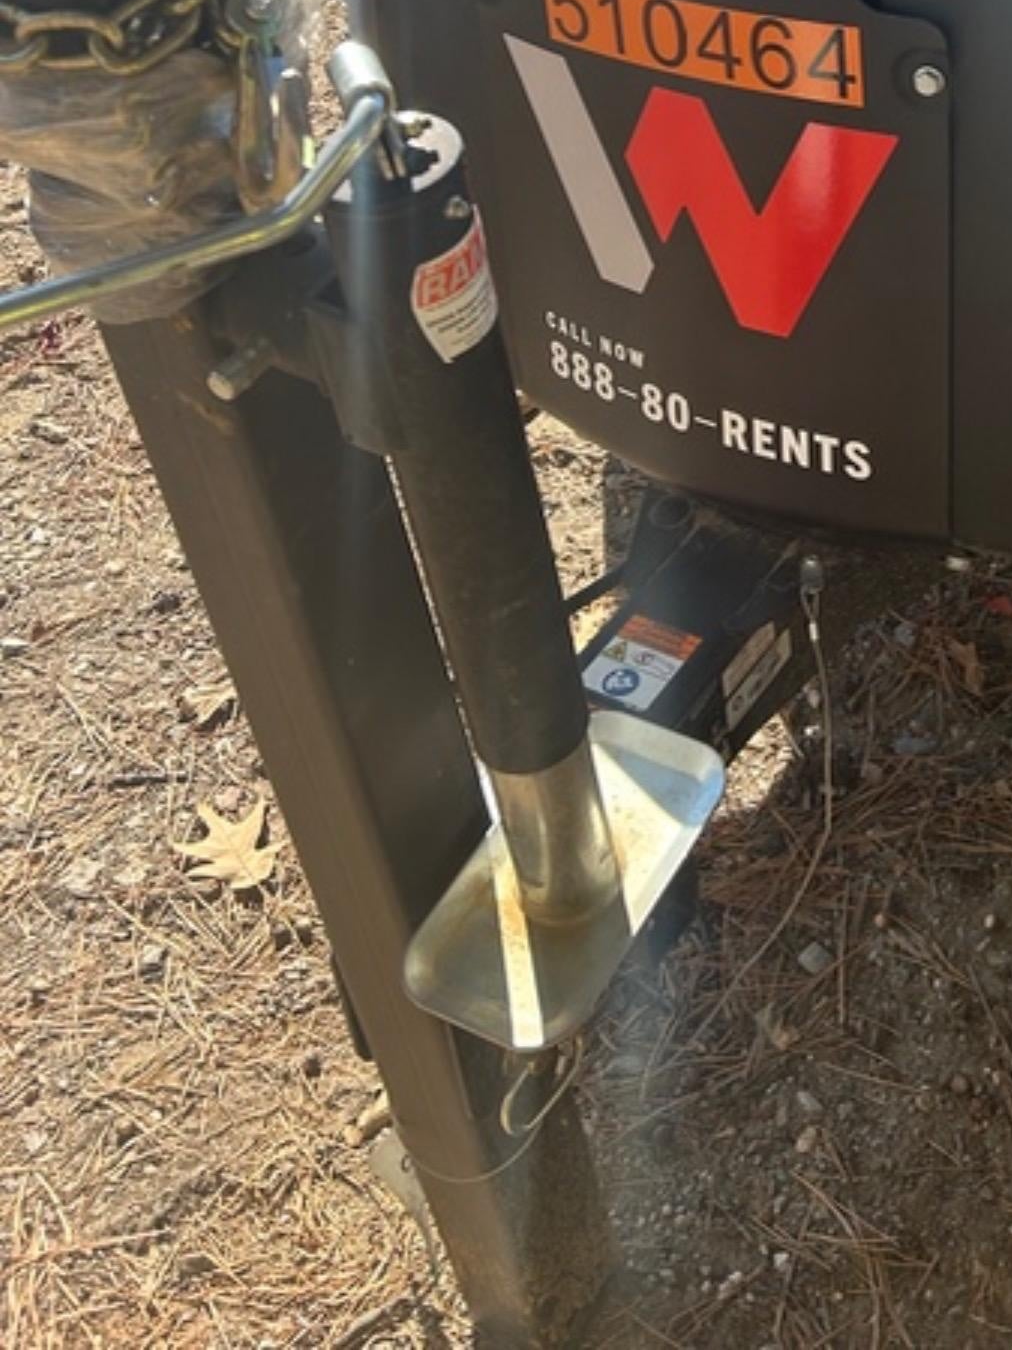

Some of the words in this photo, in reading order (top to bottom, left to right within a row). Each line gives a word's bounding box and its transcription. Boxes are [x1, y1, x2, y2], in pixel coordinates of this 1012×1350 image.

[544, 310, 593, 347] CALL
[598, 336, 646, 369] NOW
[549, 340, 873, 481] 888-80-RENTS
